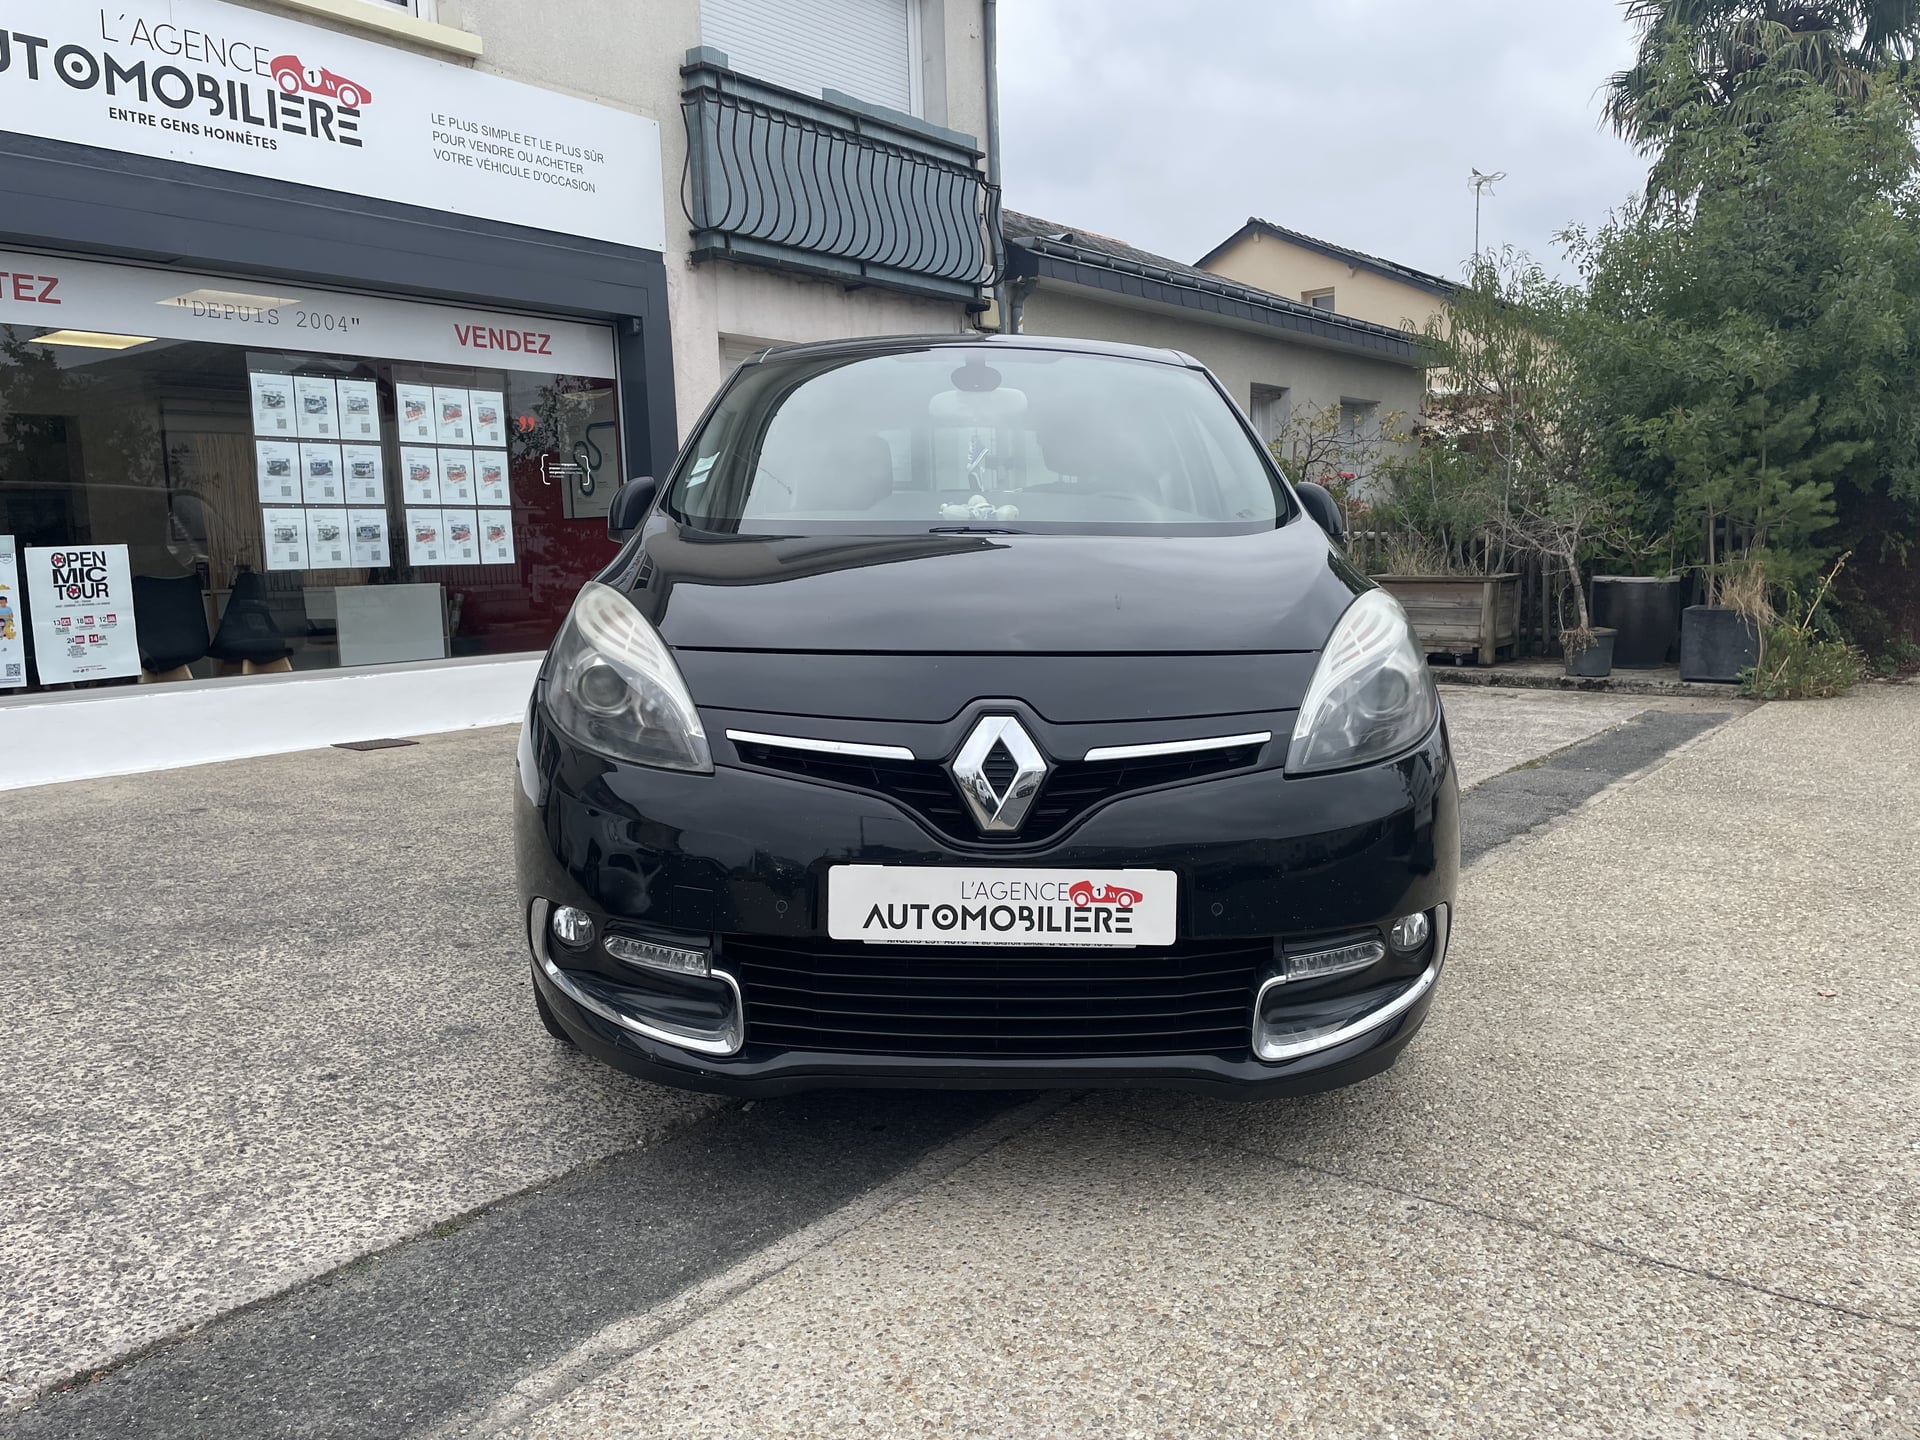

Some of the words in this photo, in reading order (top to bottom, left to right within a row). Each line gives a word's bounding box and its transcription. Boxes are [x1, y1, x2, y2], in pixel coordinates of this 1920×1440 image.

[101, 8, 272, 78] L'AGENCE
[109, 107, 156, 127] ENTRE
[160, 117, 200, 136] GENS
[203, 126, 278, 151] HONNÊTES
[431, 112, 446, 126] LE
[448, 117, 479, 134] PLUS
[480, 125, 521, 144] SIMPLE
[523, 135, 538, 148] ET
[539, 139, 553, 152] LE
[555, 143, 582, 158] PLUS
[583, 149, 605, 164] SÛR
[433, 131, 466, 148] POUR
[468, 138, 515, 160] VENDRE
[517, 150, 534, 163] OU
[535, 154, 585, 175] ACHETER
[433, 147, 474, 167] VOTRE
[475, 157, 531, 179] VÉHICULE
[533, 170, 596, 193] D'OCCASION
[453, 323, 552, 355] VENDEZ
[51, 551, 107, 568] OPEN
[52, 567, 107, 584] MIC
[54, 583, 109, 600] TOUR
[960, 881, 1070, 901] L'AGENCE
